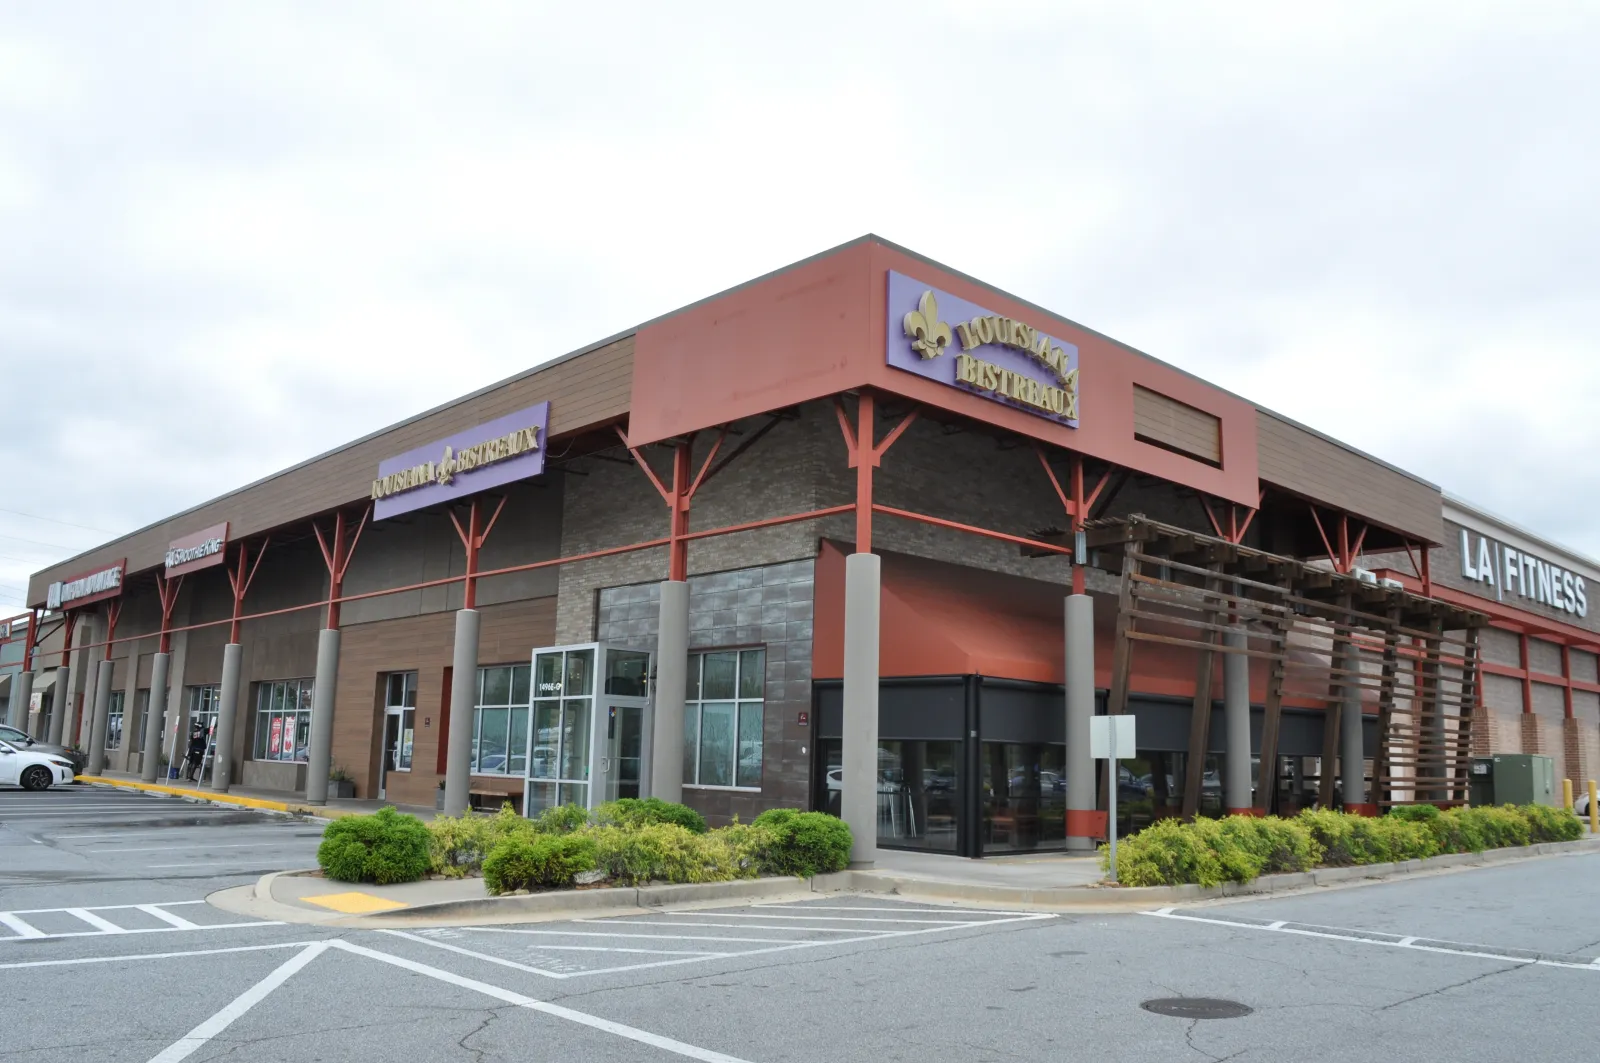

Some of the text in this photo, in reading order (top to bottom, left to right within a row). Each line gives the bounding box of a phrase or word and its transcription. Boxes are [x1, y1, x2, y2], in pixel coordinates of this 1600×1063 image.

[954, 315, 1079, 392] LOUISIANA
[954, 353, 1079, 420] BISTREAUX
[371, 425, 541, 500] LOUISIANA BISTREAUX
[1459, 529, 1588, 618] LA FITNESS
